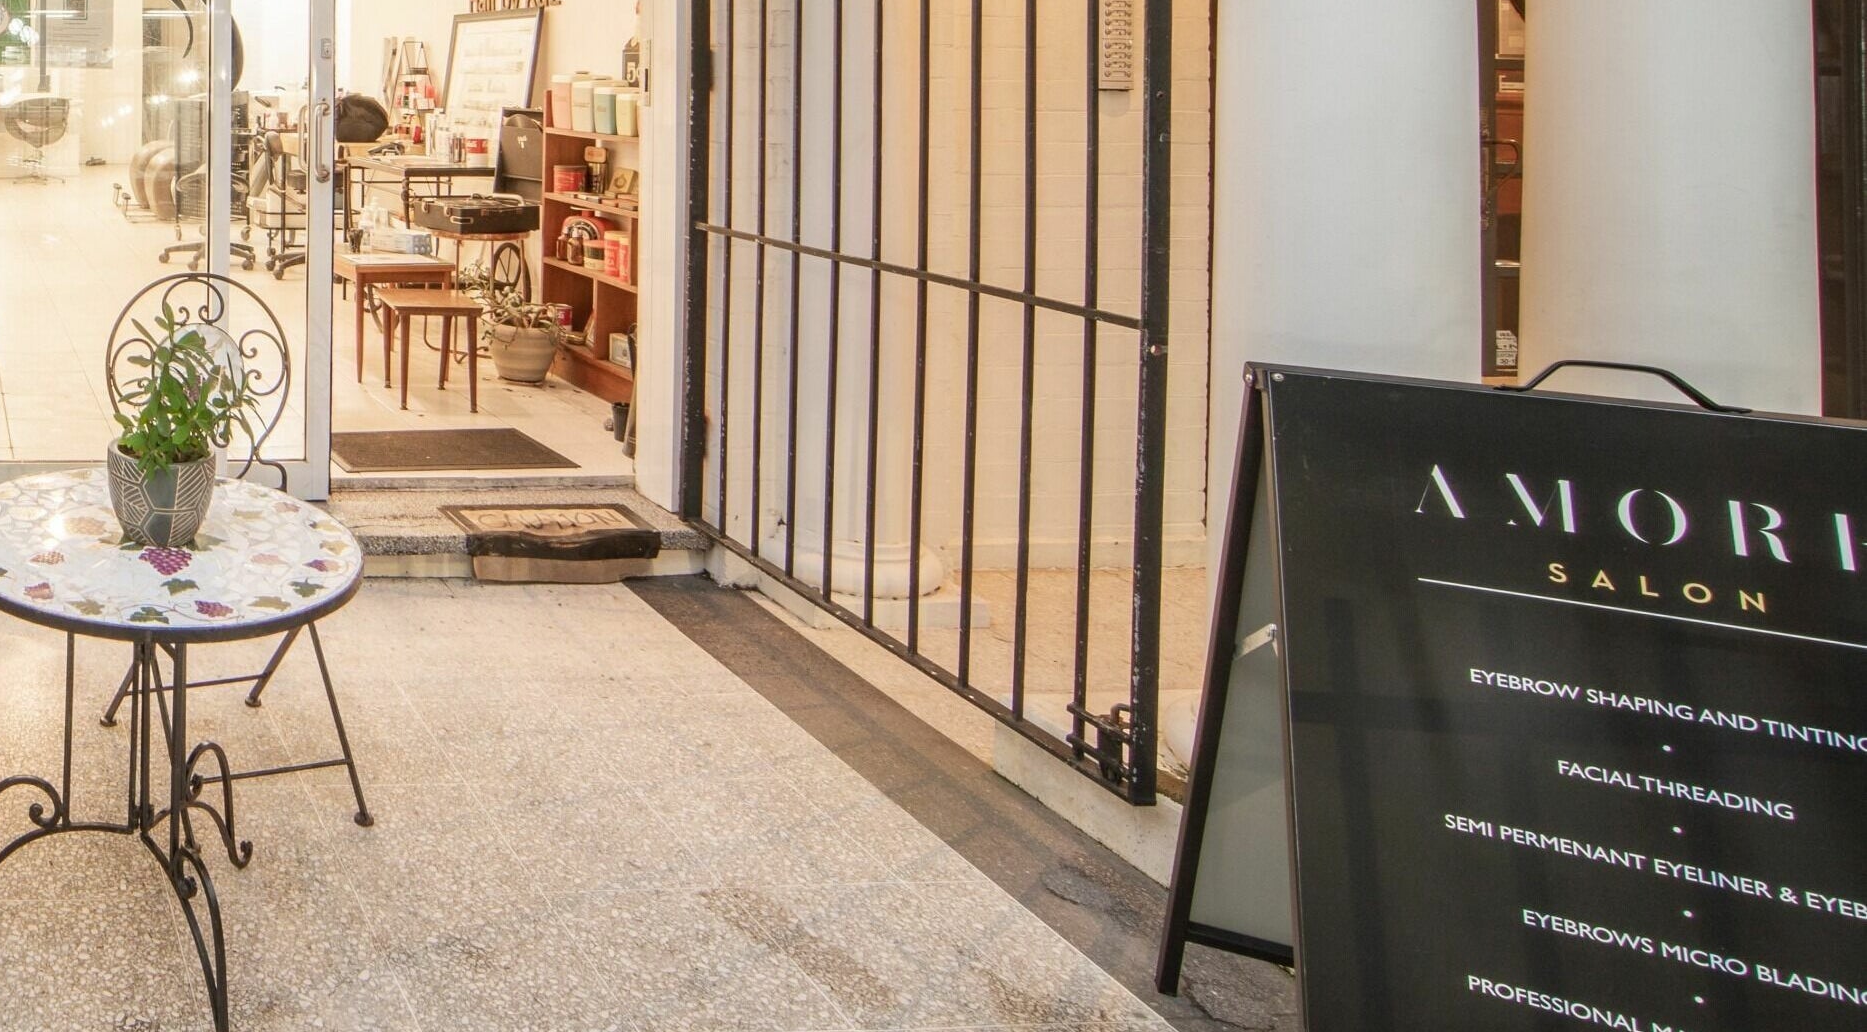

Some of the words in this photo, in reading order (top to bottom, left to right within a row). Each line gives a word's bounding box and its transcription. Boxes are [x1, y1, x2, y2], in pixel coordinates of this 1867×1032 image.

[1548, 562, 1767, 614] SALON
[1469, 668, 1580, 700] EYEBROW
[1586, 688, 1694, 722] SHAPING
[1699, 708, 1758, 732] AND
[1557, 759, 1640, 791] FACIAL
[1639, 775, 1795, 821] THREADING
[1444, 813, 1493, 838] SEMI
[1499, 825, 1646, 871] PERMENANT
[1653, 858, 1772, 901] EYELINER
[1779, 886, 1799, 906] &
[1522, 908, 1655, 954] EYEBROWS
[1661, 941, 1748, 977] MICRO
[1467, 974, 1642, 1032] PROFESSIONAL
